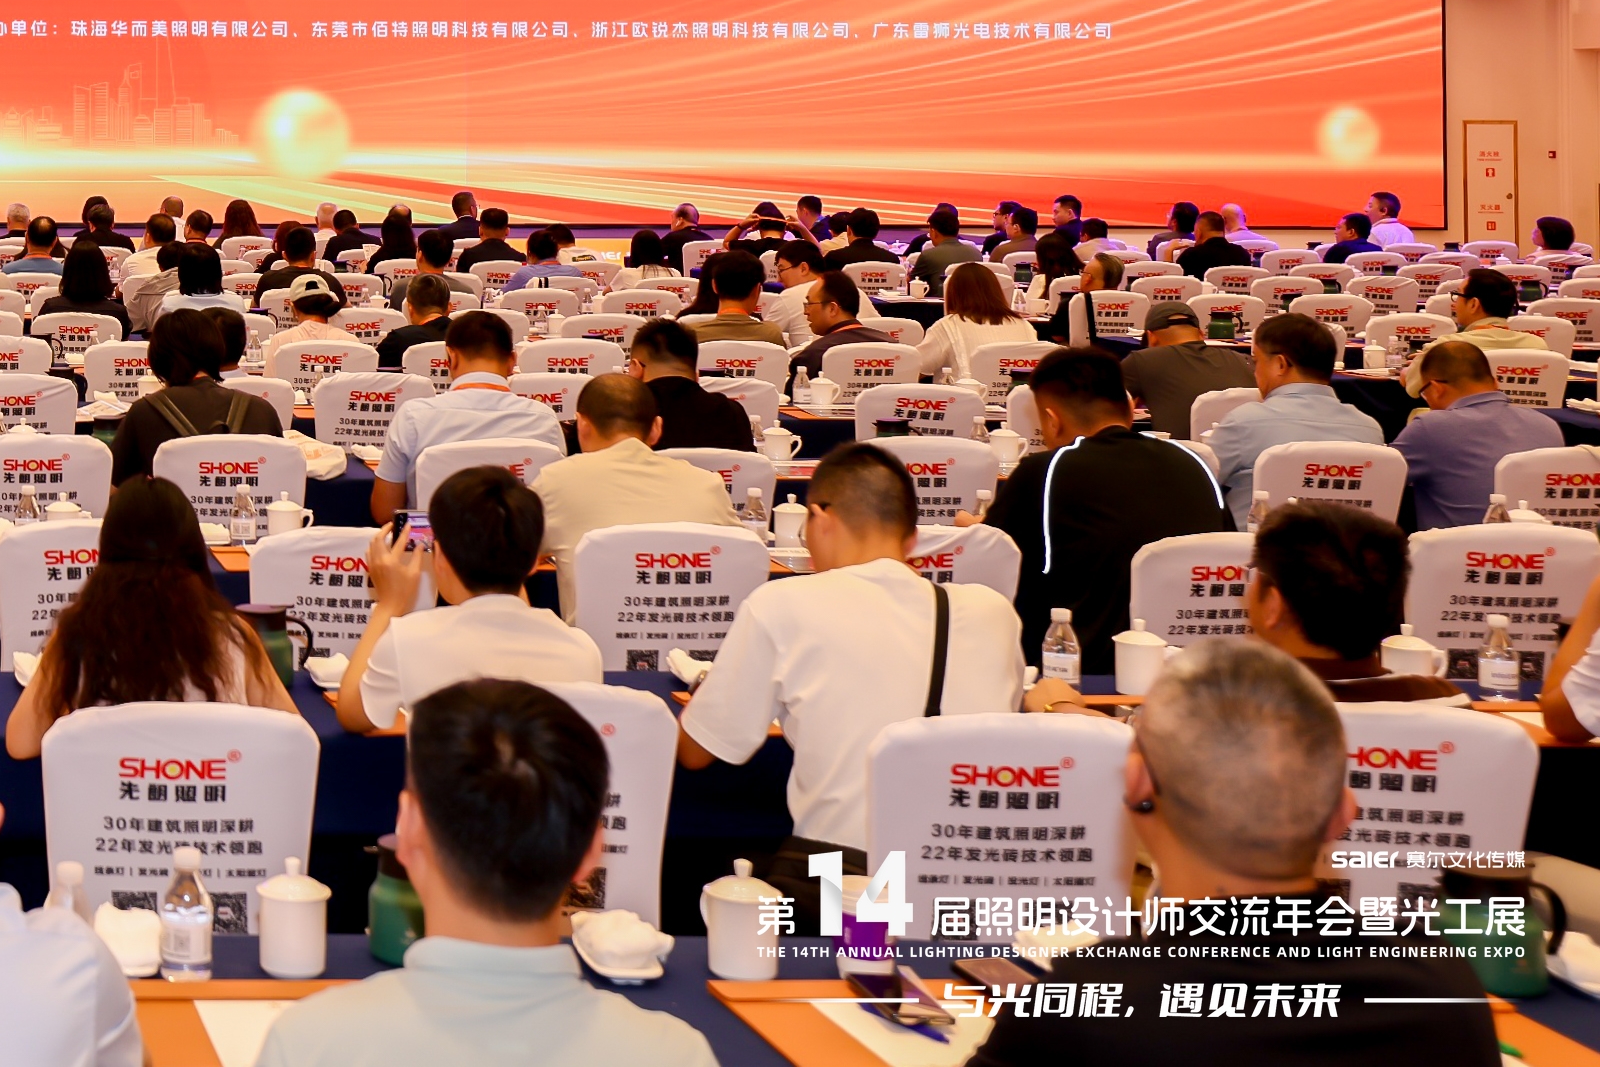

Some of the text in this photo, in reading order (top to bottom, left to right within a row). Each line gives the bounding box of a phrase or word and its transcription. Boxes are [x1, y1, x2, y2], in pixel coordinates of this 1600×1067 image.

[310, 555, 369, 573] SHON
[623, 595, 730, 608] 30年建筑照明深耕
[1449, 594, 1559, 608] 30年建筑照明深耕
[617, 611, 734, 624] 22年发光砖技术领跑
[1348, 746, 1438, 771] HONE
[103, 816, 255, 835] 30年建筑照明深耕
[931, 823, 1087, 841] 30年建筑照明深耕
[921, 845, 1094, 864] 22年发光砖技术领跑
